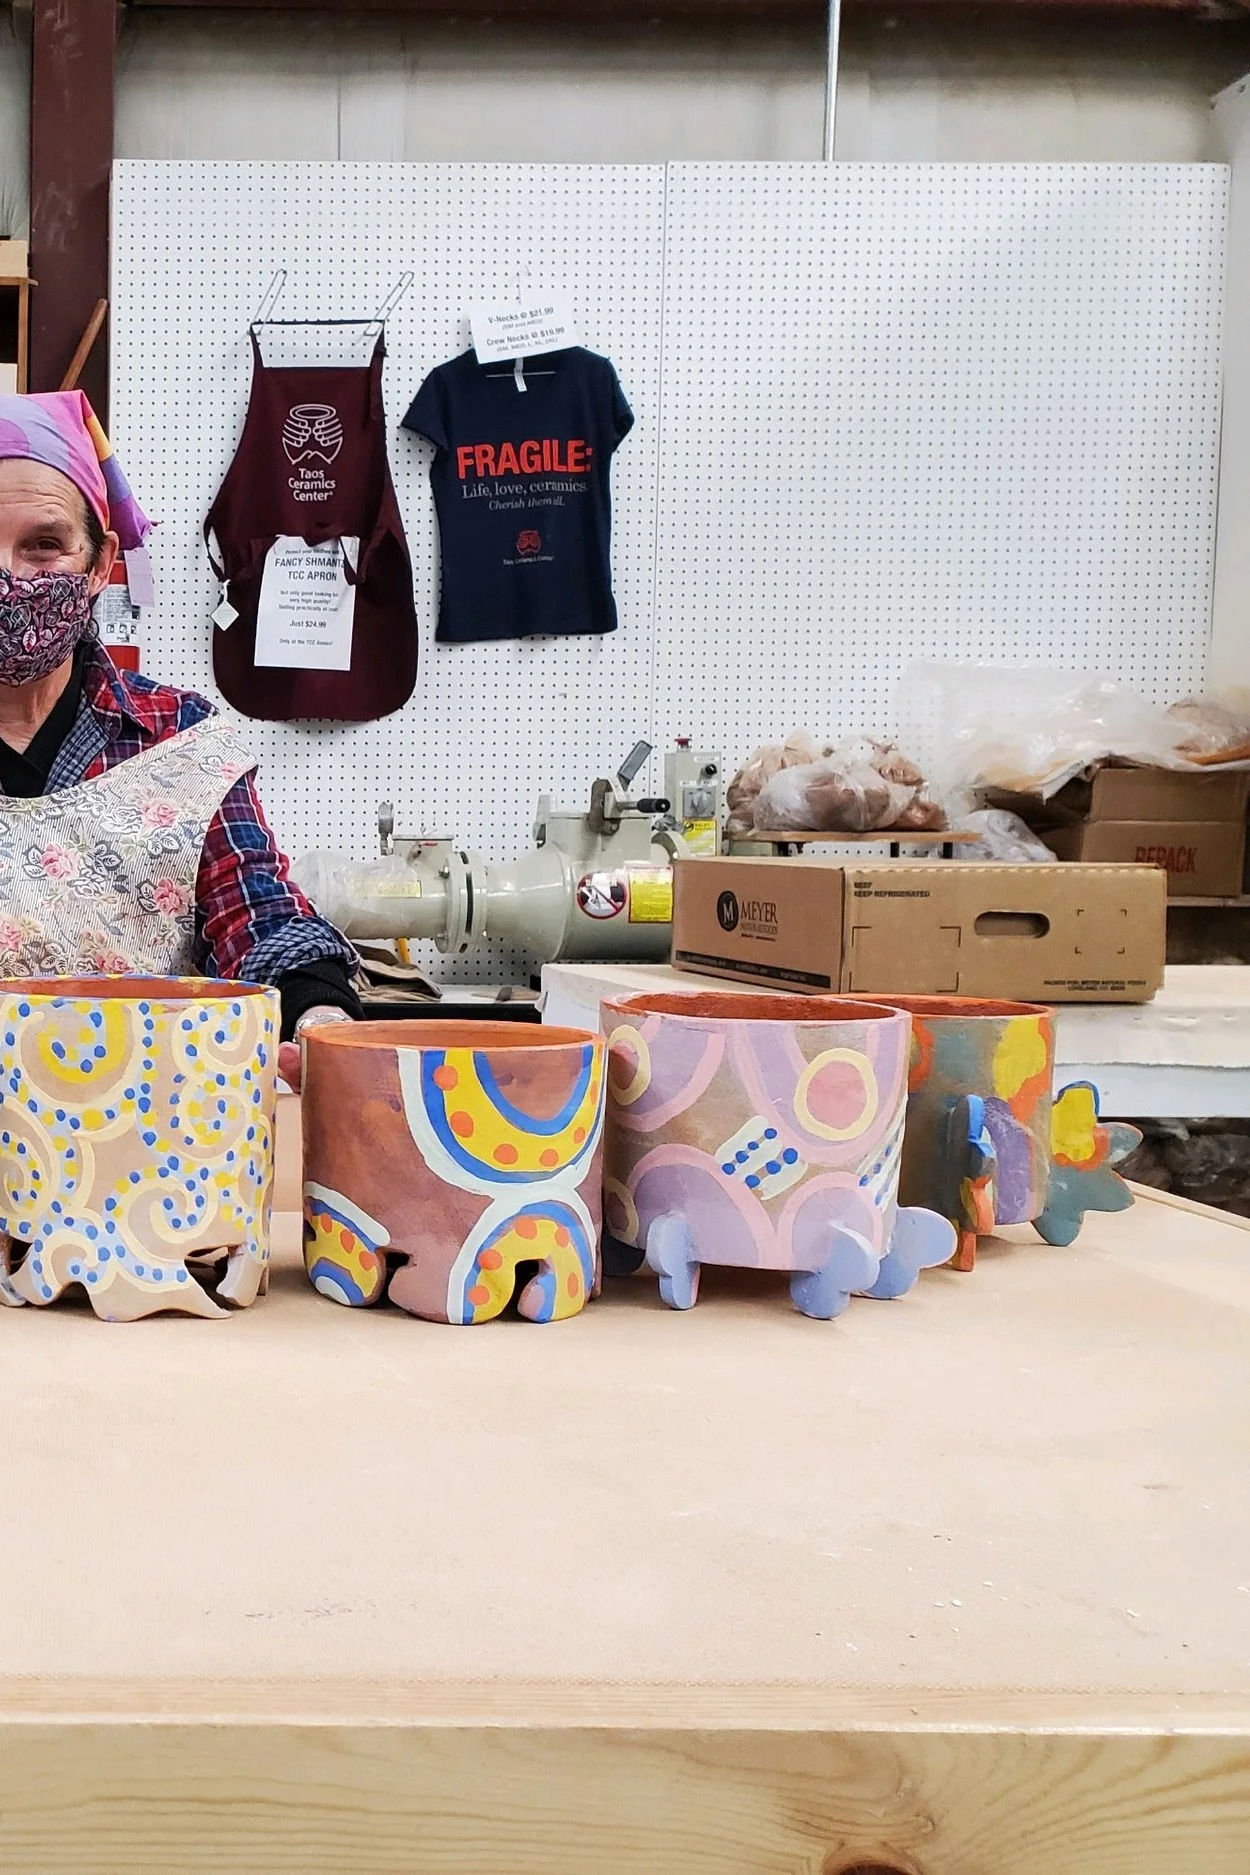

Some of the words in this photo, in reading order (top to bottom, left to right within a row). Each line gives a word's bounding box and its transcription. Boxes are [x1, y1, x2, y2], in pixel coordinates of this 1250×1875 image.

[488, 314, 519, 324] V-Necks
[486, 337, 505, 347] Crew
[507, 333, 530, 343] Necks
[456, 438, 593, 480] FRAGILE:
[299, 468, 325, 479] Taos
[288, 478, 336, 490] Ceramics
[462, 484, 493, 499] Life,
[495, 482, 527, 496] love,
[489, 498, 525, 511] Cherish
[528, 496, 552, 507] them
[275, 558, 303, 567] FANCY
[288, 571, 304, 580] TCC
[307, 571, 337, 581] APRON
[740, 901, 778, 924] MEYER
